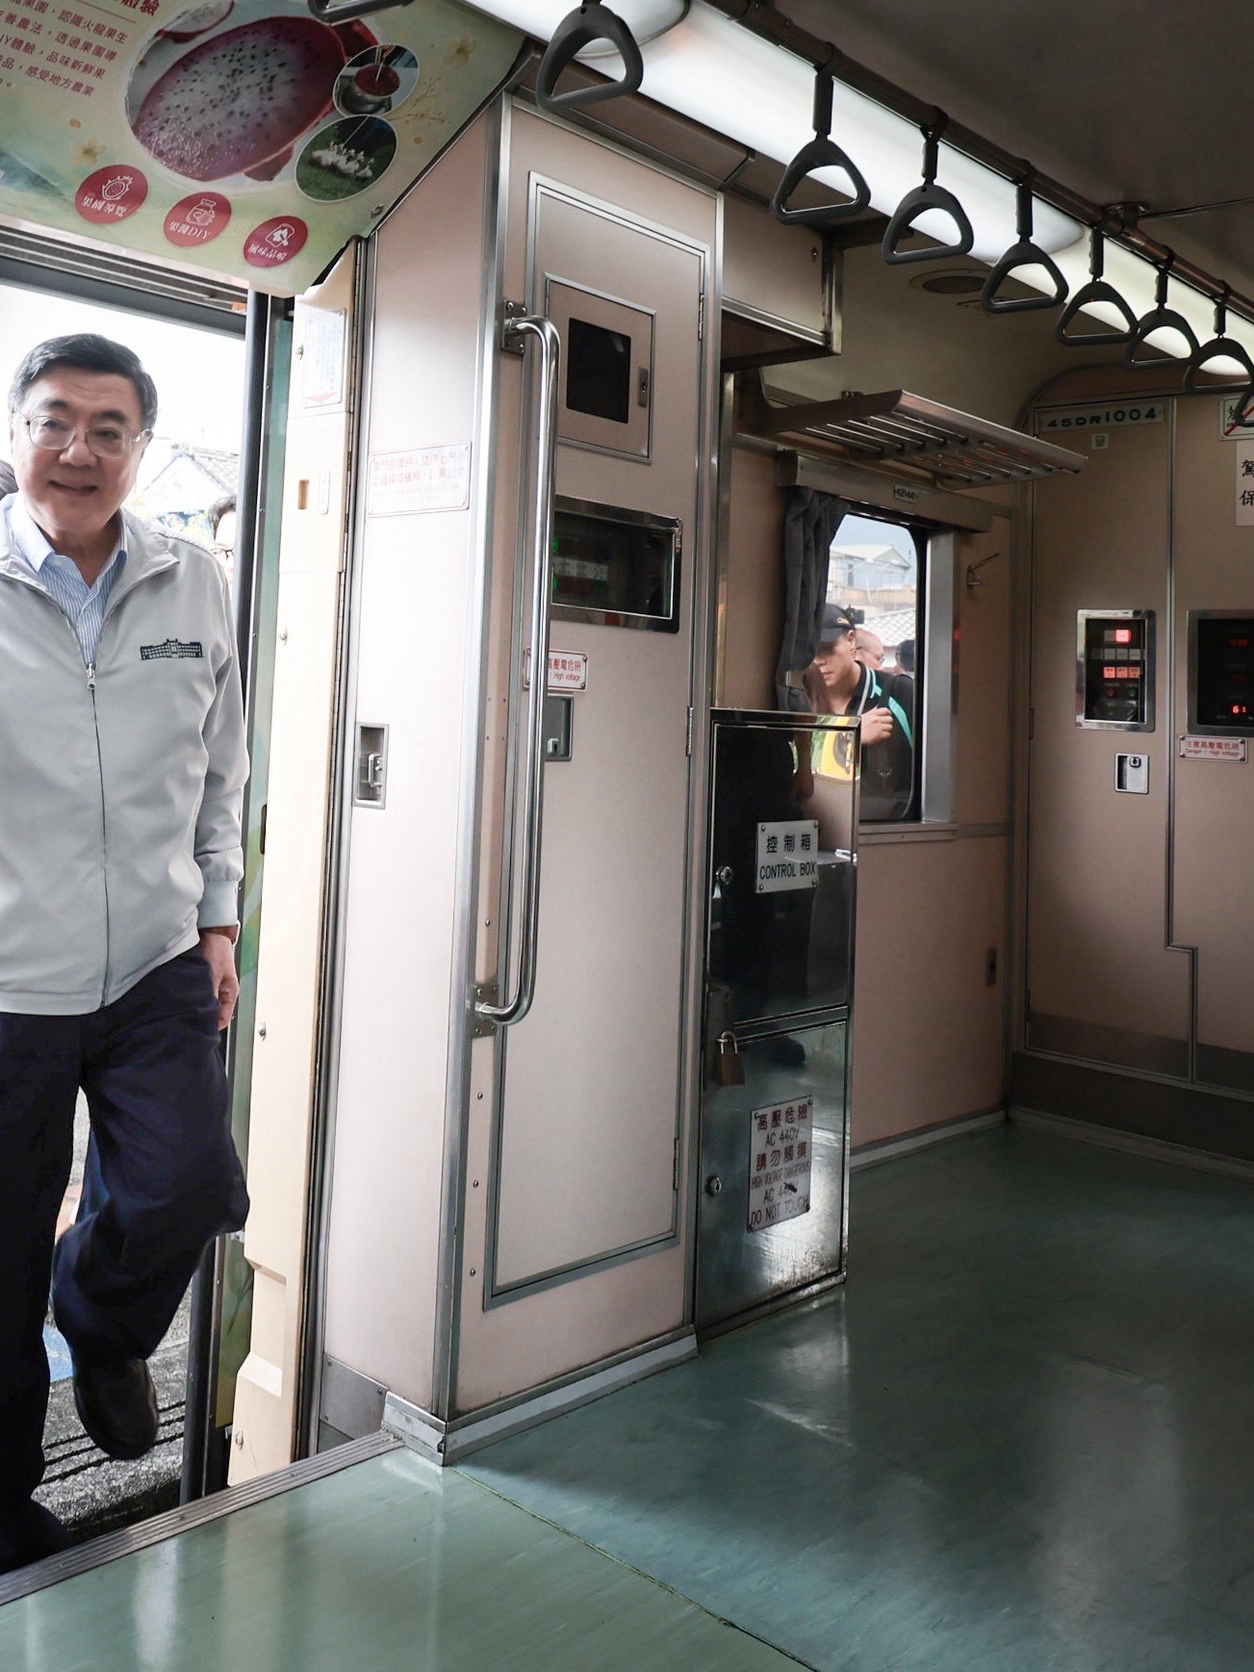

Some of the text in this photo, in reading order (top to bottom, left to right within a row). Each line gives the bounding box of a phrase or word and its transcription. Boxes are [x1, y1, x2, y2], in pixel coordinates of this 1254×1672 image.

[1048, 407, 1157, 427] 45DR1004
[766, 833, 811, 854] 控制箱
[759, 863, 816, 880] CONTROL BOX
[757, 1104, 807, 1132] 高壓危險
[766, 1132, 775, 1148] AC
[764, 1188, 774, 1204] AC
